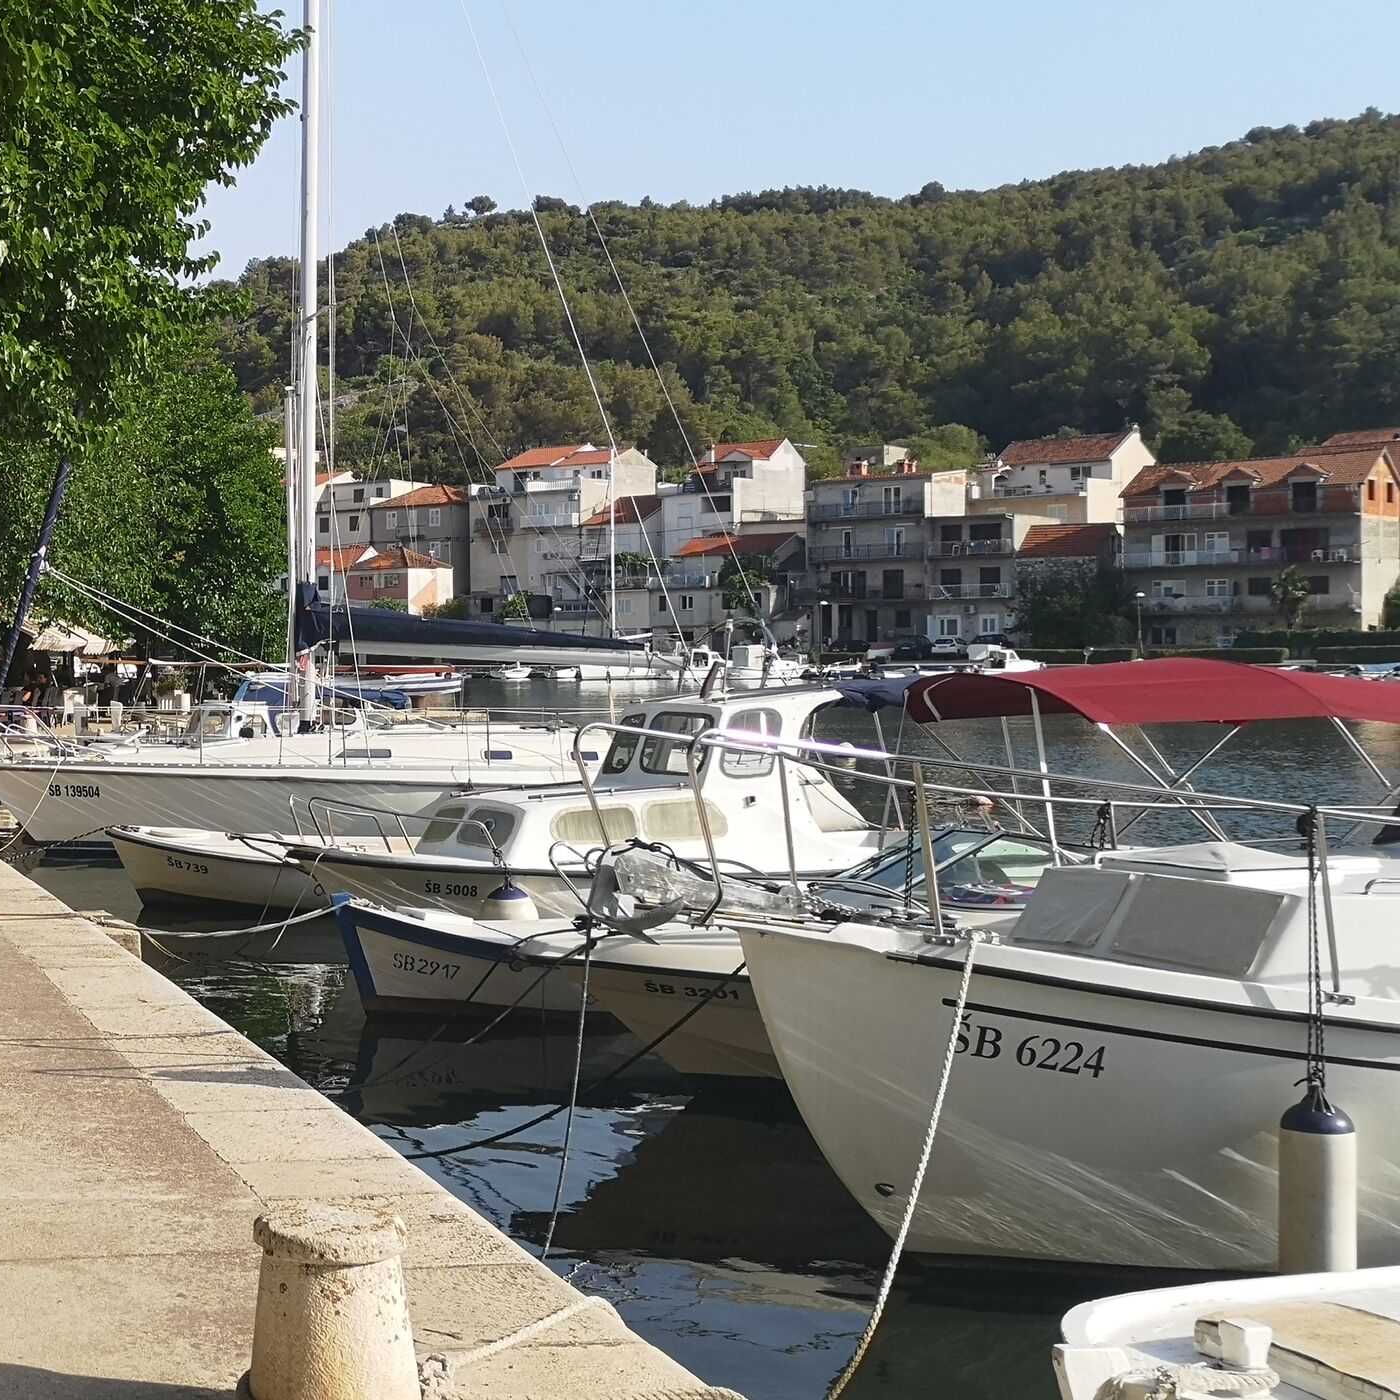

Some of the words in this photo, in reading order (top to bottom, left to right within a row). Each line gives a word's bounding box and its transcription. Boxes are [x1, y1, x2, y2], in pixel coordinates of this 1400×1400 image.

[64, 784, 100, 798] 139504
[424, 880, 441, 894] ŠB
[445, 884, 478, 897] 5008
[684, 986, 739, 1000] 3201
[954, 1013, 1002, 1059] ŠB
[1015, 1035, 1106, 1078] 6224
